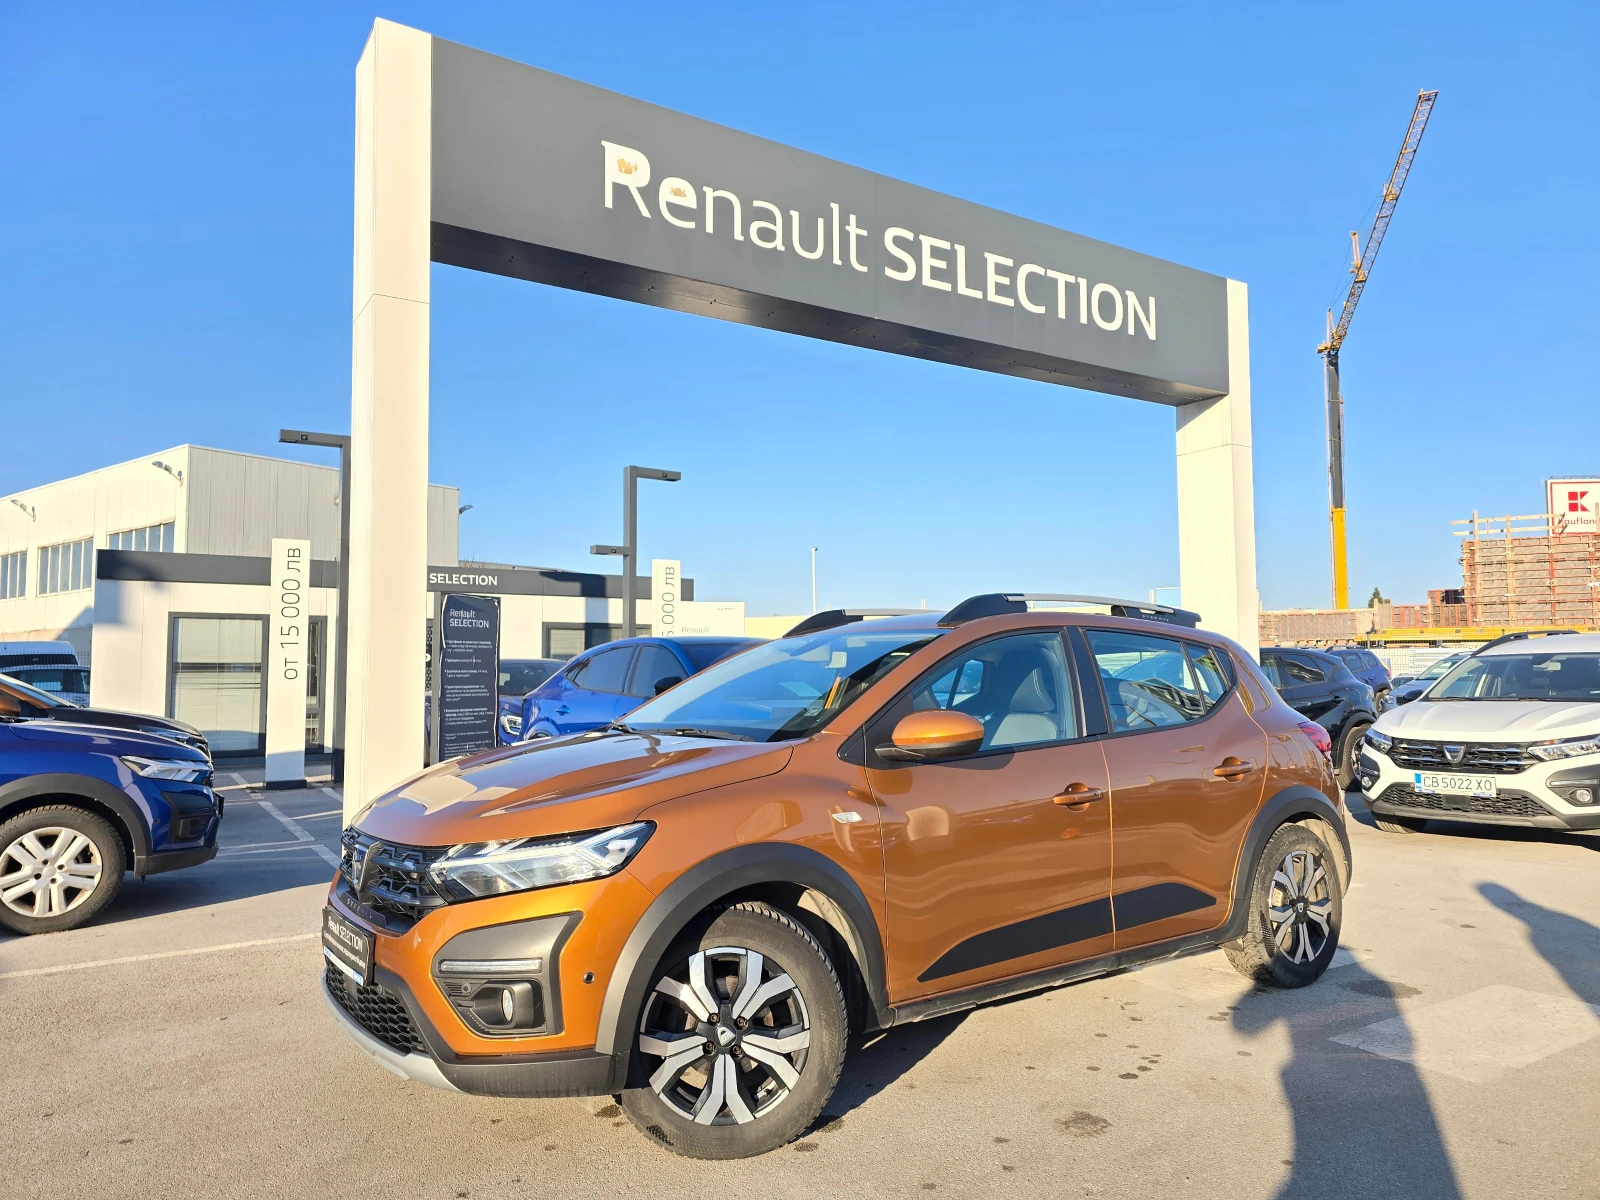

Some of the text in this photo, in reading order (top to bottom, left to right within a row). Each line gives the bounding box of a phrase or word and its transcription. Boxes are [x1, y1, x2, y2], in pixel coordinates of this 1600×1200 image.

[600, 140, 1157, 341] Renault SELECTION
[429, 572, 498, 586] SELECTION
[280, 578, 301, 618] 000
[661, 592, 675, 625] 000
[449, 608, 476, 618] Renault
[449, 618, 490, 629] SELECTION
[280, 625, 300, 649] 15
[681, 626, 710, 634] Renault
[283, 657, 298, 680] от
[1441, 777, 1473, 790] 5022
[339, 926, 363, 953] SELECTION
